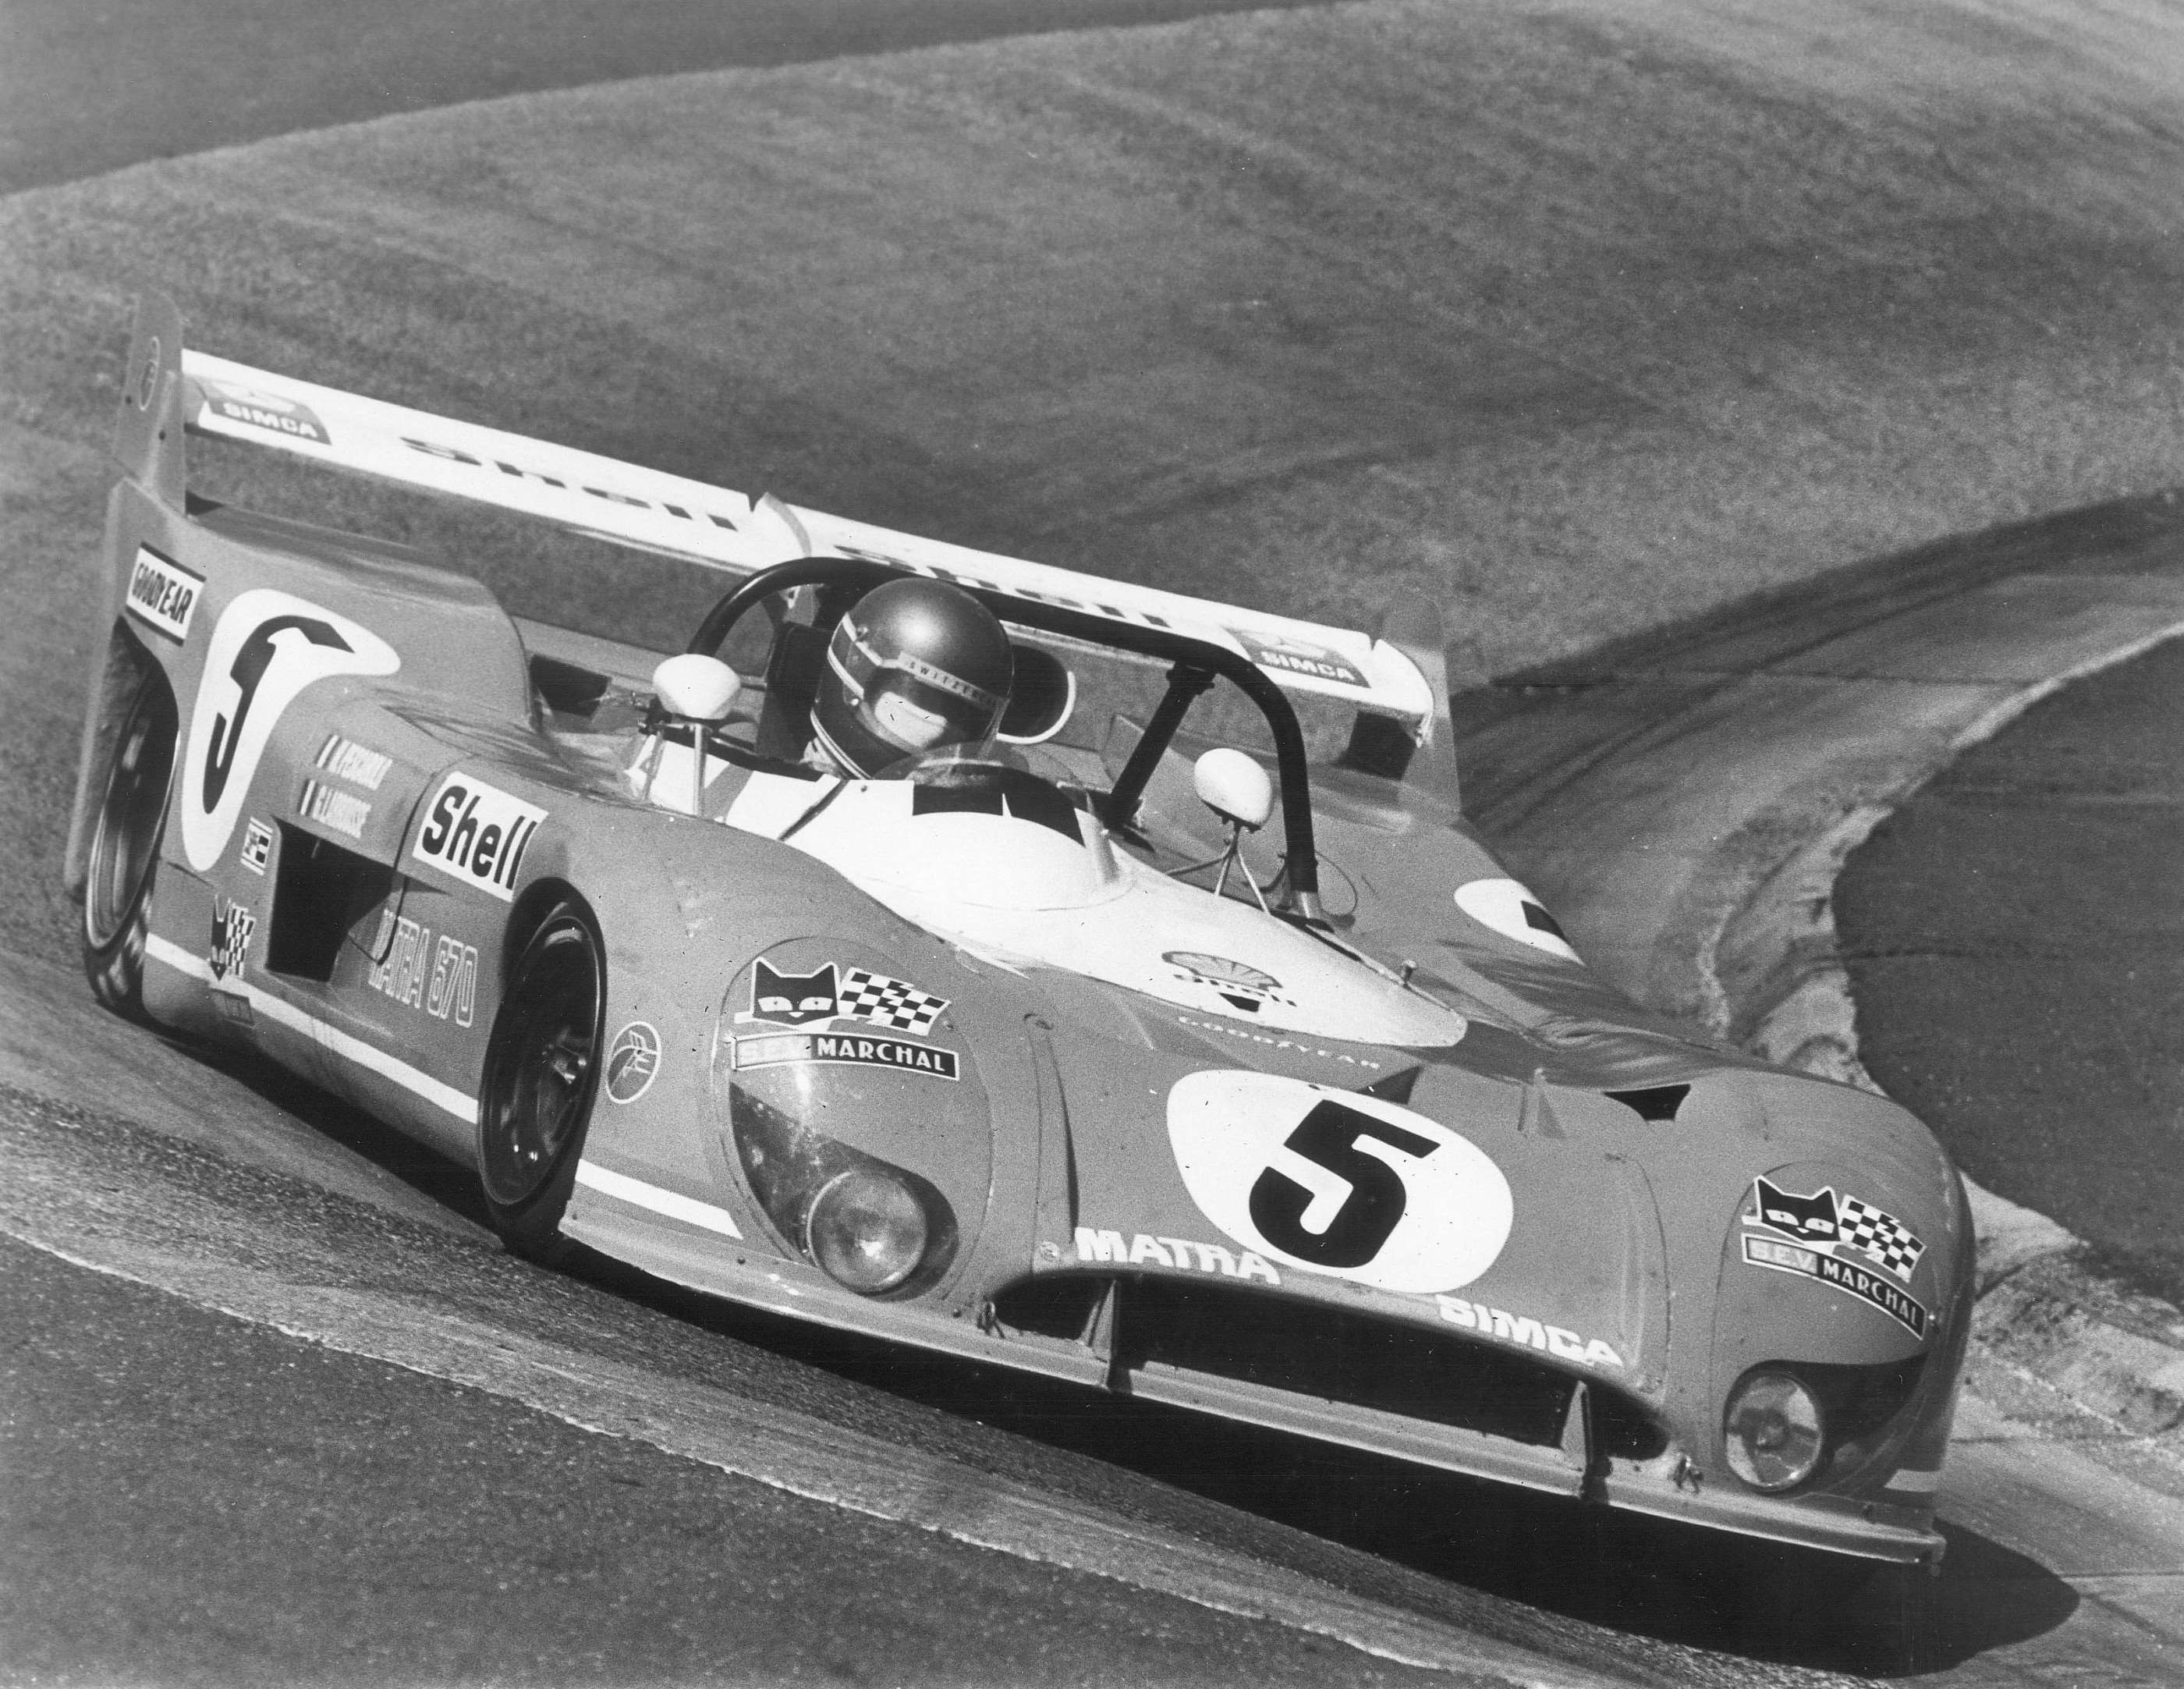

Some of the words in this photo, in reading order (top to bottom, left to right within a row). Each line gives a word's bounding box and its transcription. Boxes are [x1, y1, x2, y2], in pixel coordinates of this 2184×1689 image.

[223, 403, 319, 438] SIMCA
[1260, 650, 1356, 682] SIMCA
[202, 614, 356, 814] 5
[422, 785, 538, 891] Shell
[427, 935, 478, 1029] 670
[817, 1037, 945, 1073] MARCHAL
[1248, 1098, 1441, 1269] 5
[1074, 1226, 1282, 1286] MATRA
[1823, 1258, 1920, 1327] MARCHAL
[1434, 1293, 1623, 1367] SIMCA
